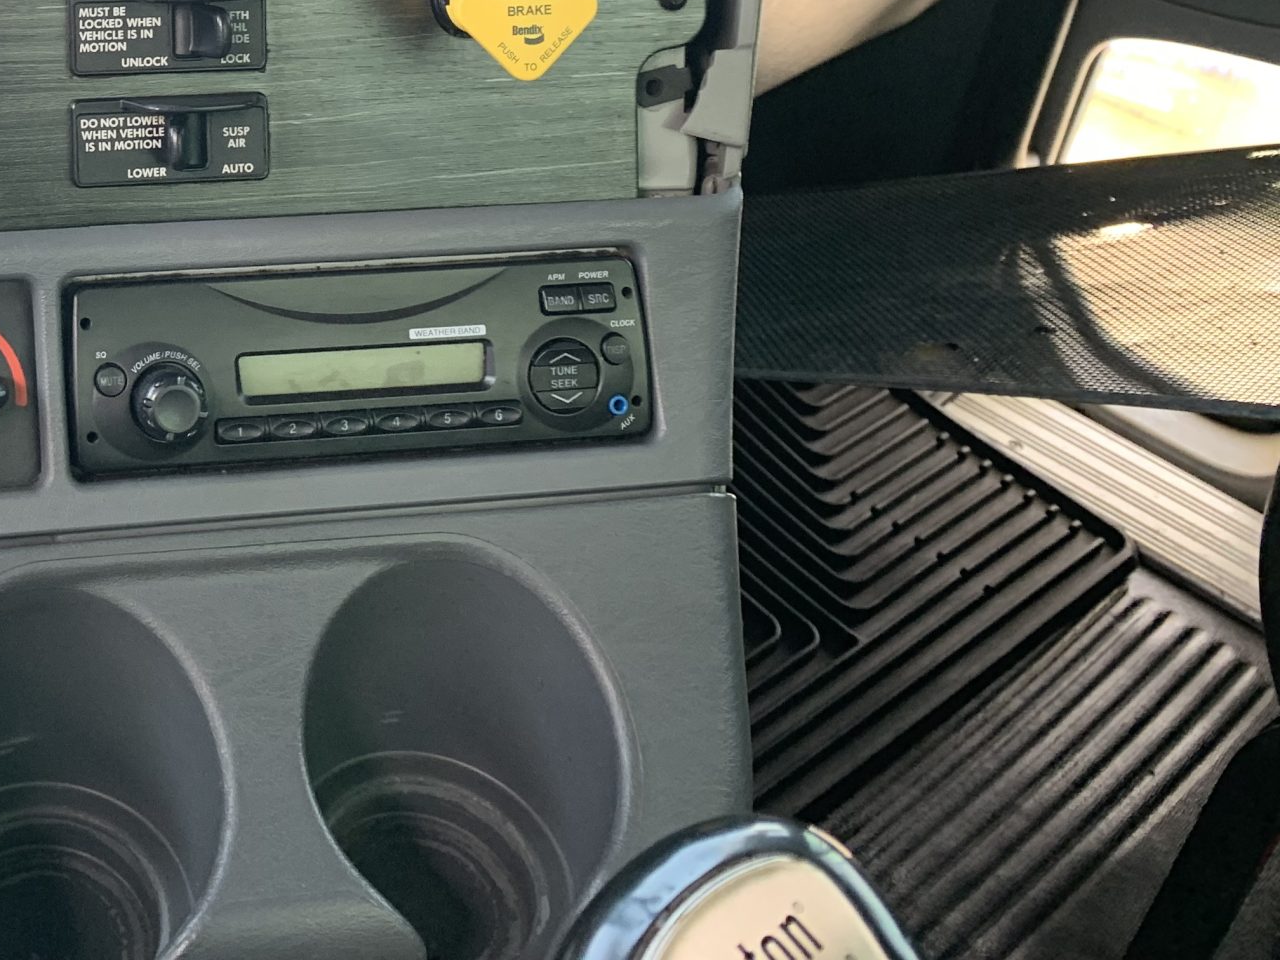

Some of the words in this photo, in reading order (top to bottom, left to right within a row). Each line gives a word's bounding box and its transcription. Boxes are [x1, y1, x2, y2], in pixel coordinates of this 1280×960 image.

[79, 7, 109, 17] MUST
[113, 7, 126, 16] BE
[508, 4, 552, 17] BRAKE
[79, 19, 123, 29] LOCKED
[127, 17, 161, 27] WHEN
[231, 22, 248, 32] HL
[79, 30, 124, 41] VEHICLE
[127, 30, 137, 39] IS
[140, 29, 153, 39] IN
[512, 24, 544, 36] Bendix
[79, 42, 127, 53] MOTION
[498, 42, 520, 64] PUSH
[525, 63, 537, 71] TO
[539, 26, 573, 63] RELEASE
[121, 56, 168, 67] UNLOCK
[221, 53, 251, 64] LOCK
[80, 119, 97, 129] DO
[100, 118, 124, 127] NOT
[127, 116, 165, 127] LOWER
[81, 129, 117, 140] WHEN
[120, 127, 165, 138] VEHICLE
[223, 127, 250, 137] SUSP
[85, 142, 95, 152] IS
[99, 142, 111, 151] IN
[114, 139, 162, 150] MOTION
[228, 139, 246, 148] AIR
[127, 167, 167, 178] LOWER
[222, 163, 254, 174] AUTO
[578, 270, 609, 279] POWER
[547, 295, 575, 305] BAND
[588, 293, 610, 304] SRC
[610, 319, 635, 327] CLOCK
[414, 328, 456, 337] WEATHER
[458, 326, 480, 335] BAND
[188, 358, 201, 371] SEL
[551, 365, 578, 376] TUNE
[100, 376, 124, 386] MUTE
[551, 378, 578, 389] SEEK
[237, 427, 243, 437] 1
[289, 423, 297, 434] 2
[341, 420, 348, 431] 3
[392, 417, 400, 427] 4
[444, 413, 451, 424] 5
[495, 410, 503, 420] 6
[620, 415, 635, 430] AUX
